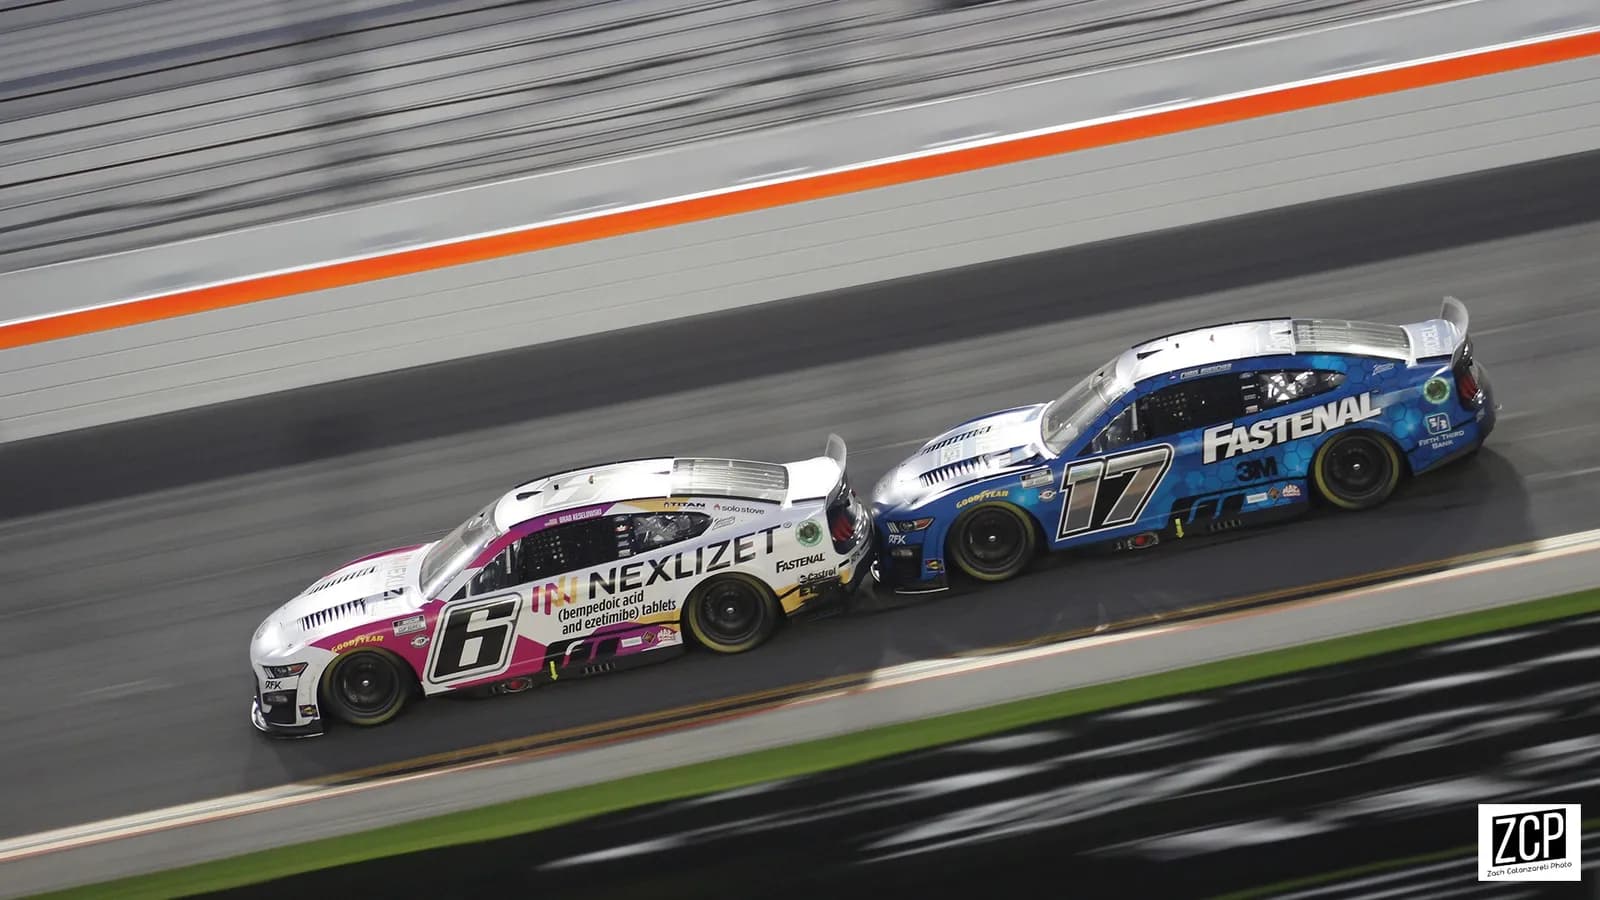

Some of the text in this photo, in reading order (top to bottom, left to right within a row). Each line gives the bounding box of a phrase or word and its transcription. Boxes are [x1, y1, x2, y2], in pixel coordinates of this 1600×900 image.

[1203, 391, 1382, 465] FASTENAL
[1418, 430, 1465, 446] FIFTH THIRD
[1432, 440, 1454, 449] BANK
[1235, 456, 1278, 481] 3M
[956, 490, 1009, 509] GOODYEAR
[1056, 442, 1175, 542] 17
[741, 506, 765, 515] stove
[776, 552, 826, 573] FASTENAL
[807, 567, 836, 581] Castrol
[558, 590, 644, 623] (bempedoic acid
[562, 598, 677, 635] and ezetimibe) tablets
[331, 634, 384, 654] GOODYEAR
[431, 597, 520, 682] 6
